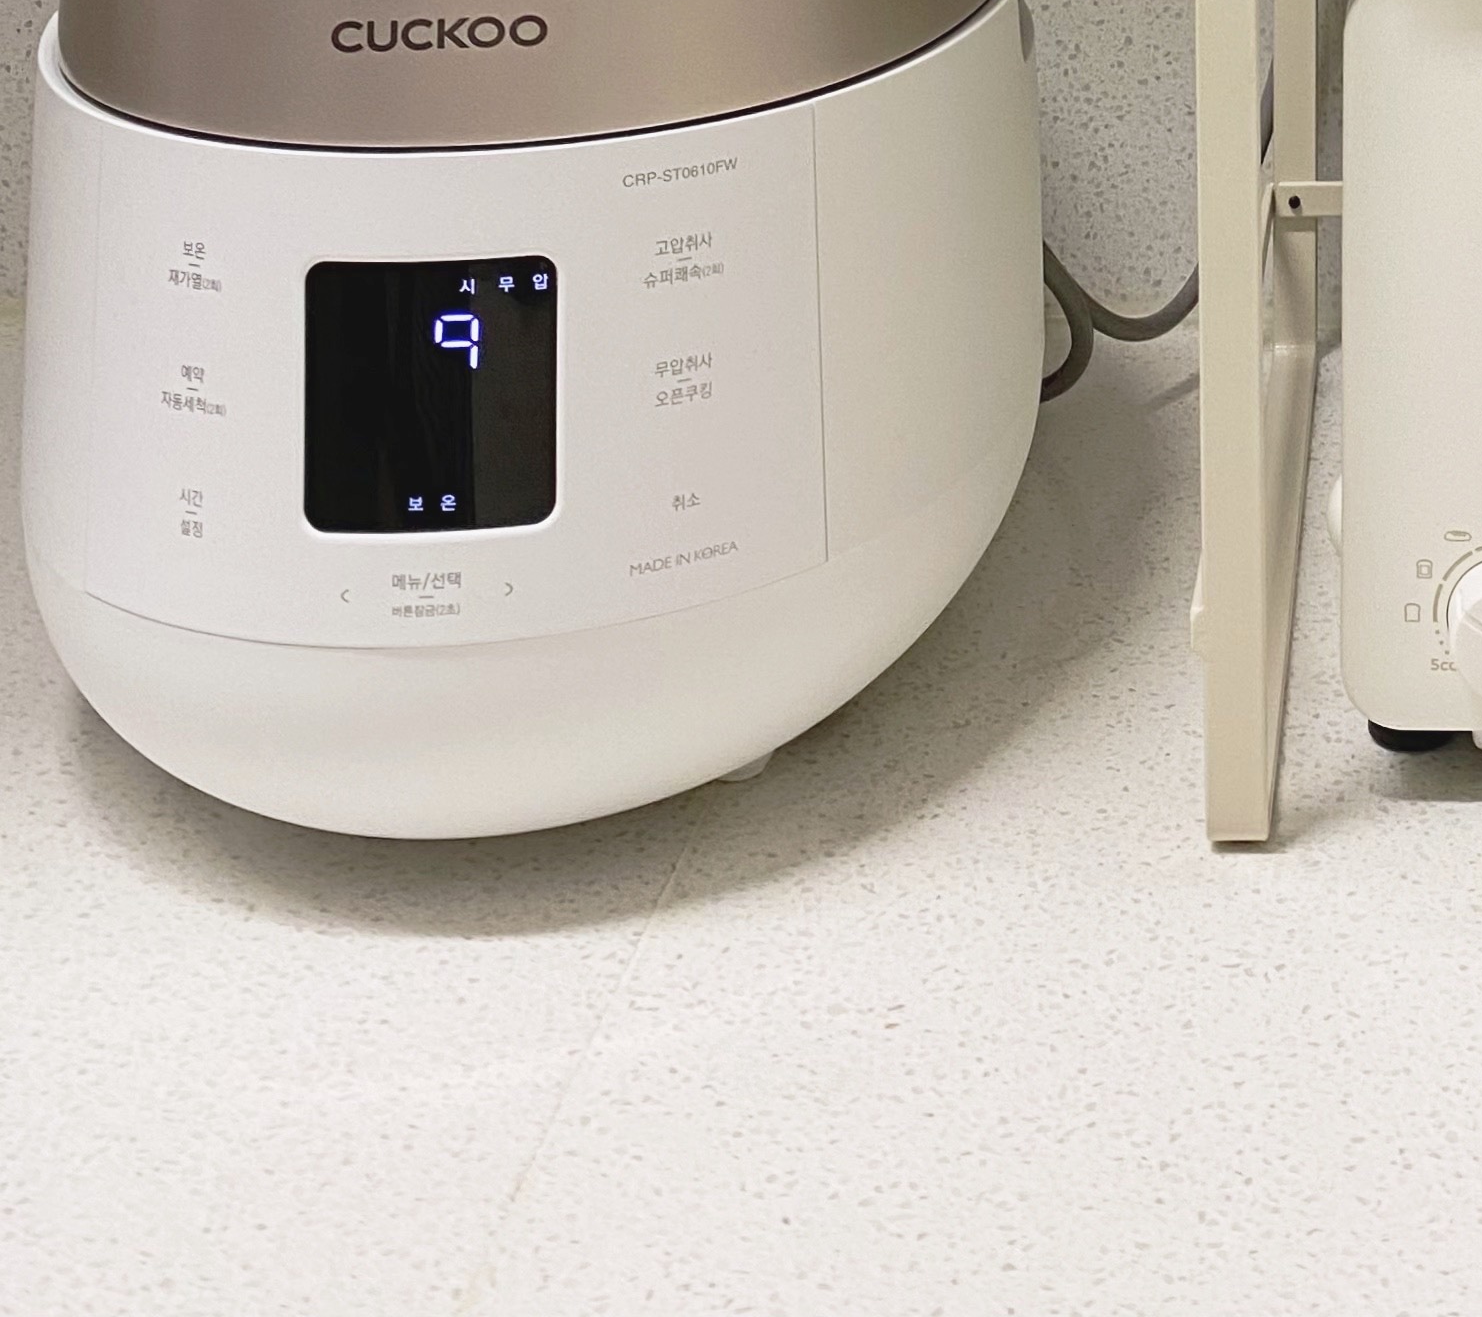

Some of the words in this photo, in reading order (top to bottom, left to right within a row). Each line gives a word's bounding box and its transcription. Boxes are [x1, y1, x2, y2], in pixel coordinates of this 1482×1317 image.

[331, 14, 548, 53] CUCKOO
[622, 157, 739, 188] CRP-ST0610FW
[182, 240, 206, 260] 보온
[654, 231, 713, 256] 고압취사
[459, 278, 477, 294] 시
[433, 312, 481, 370] 9
[181, 364, 205, 384] 예약
[654, 351, 713, 378] 무압취사
[654, 380, 713, 408] 오픈쿠킹
[179, 488, 203, 508] 시간
[672, 492, 701, 511] 취소
[180, 519, 204, 539] 설정
[629, 556, 673, 577] MADE
[675, 551, 691, 566] IN
[693, 540, 739, 562] KOREA
[391, 571, 462, 591] 메뉴/선택
